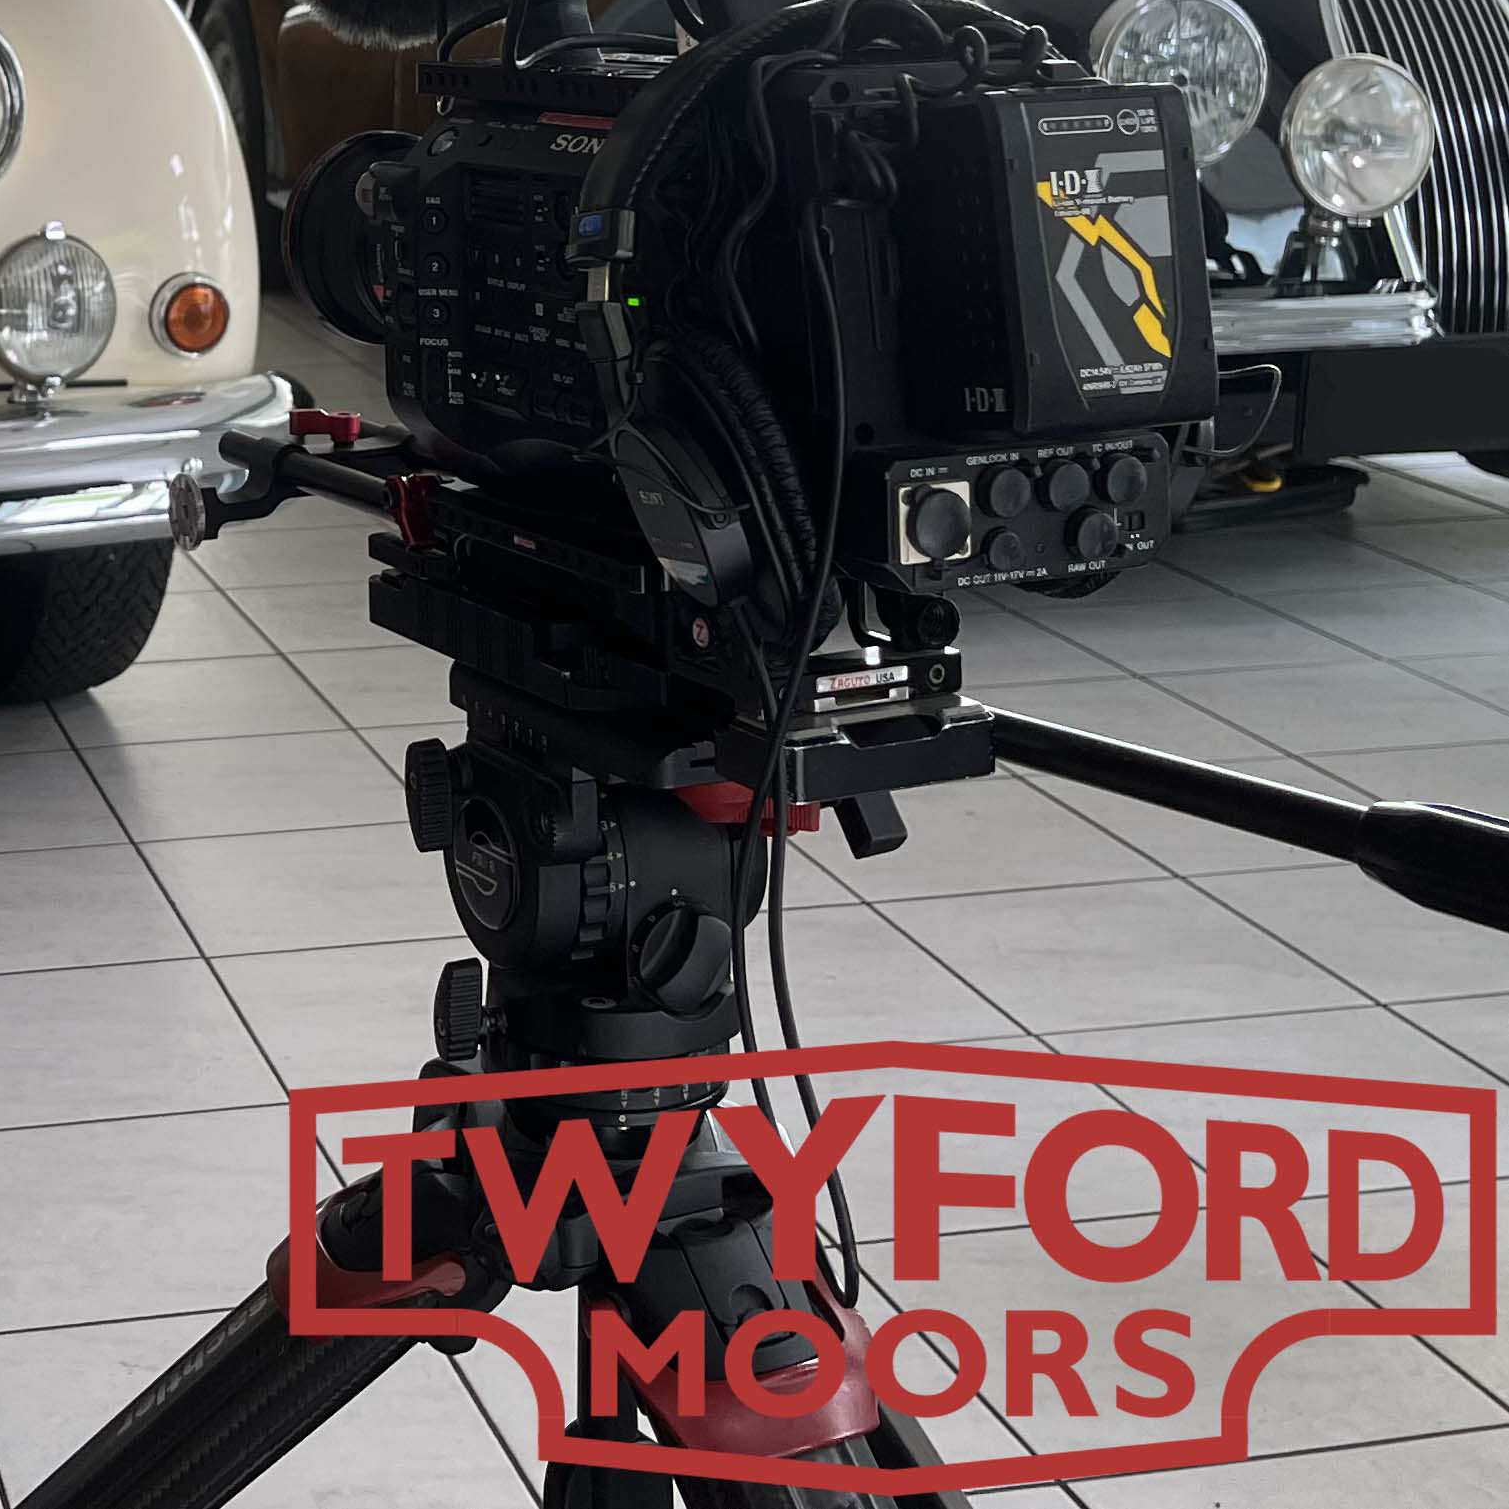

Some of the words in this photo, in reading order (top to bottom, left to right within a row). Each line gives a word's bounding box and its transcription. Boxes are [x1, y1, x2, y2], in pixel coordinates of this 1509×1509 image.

[550, 133, 606, 155] SON
[431, 262, 439, 272] 2
[432, 308, 440, 319] 3
[419, 337, 450, 347] FOCUS
[1037, 448, 1054, 458] REF
[1055, 446, 1074, 457] OUT
[1092, 442, 1103, 453] TC
[966, 454, 1008, 466] GENLOCK
[1009, 452, 1019, 461] IN
[910, 468, 923, 478] DC
[925, 467, 935, 477] IN
[1137, 539, 1154, 551] OUT
[1068, 561, 1087, 573] RAW
[1088, 560, 1106, 571] OUT
[958, 576, 971, 587] DC
[973, 574, 991, 586] OUT
[875, 672, 895, 684] USA
